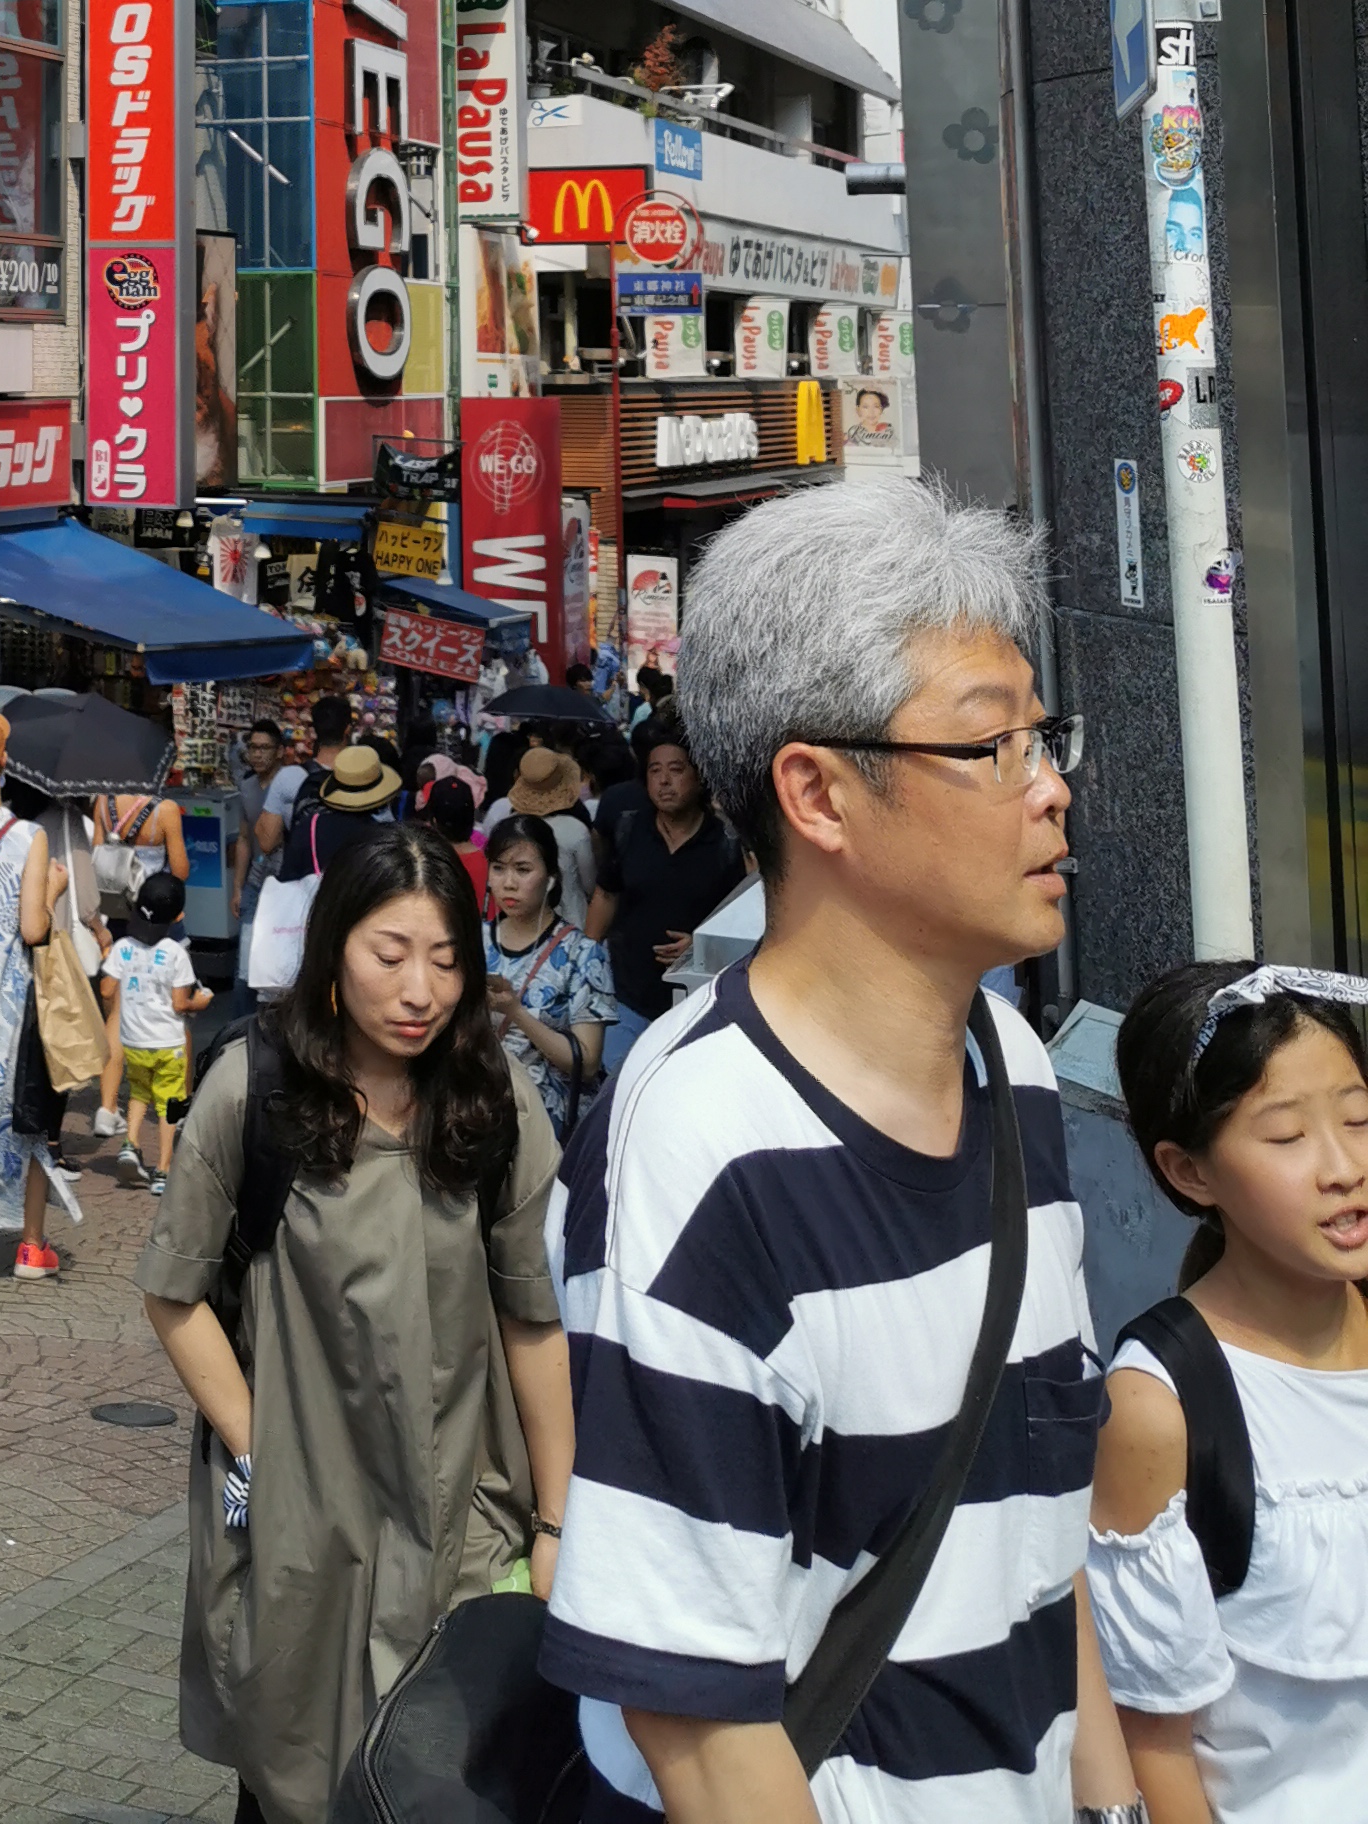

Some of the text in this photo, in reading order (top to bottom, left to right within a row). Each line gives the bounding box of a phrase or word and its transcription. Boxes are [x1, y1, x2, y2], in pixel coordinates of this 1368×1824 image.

[110, 2, 155, 232] OSドラッグ
[458, 78, 508, 203] Pausa
[633, 220, 684, 244] 消火栓
[379, 530, 443, 553] ハッピーワン
[375, 550, 441, 577] HAPPY ONE
[382, 646, 479, 676] SQUEEZE
[384, 626, 481, 666] スクイーズ
